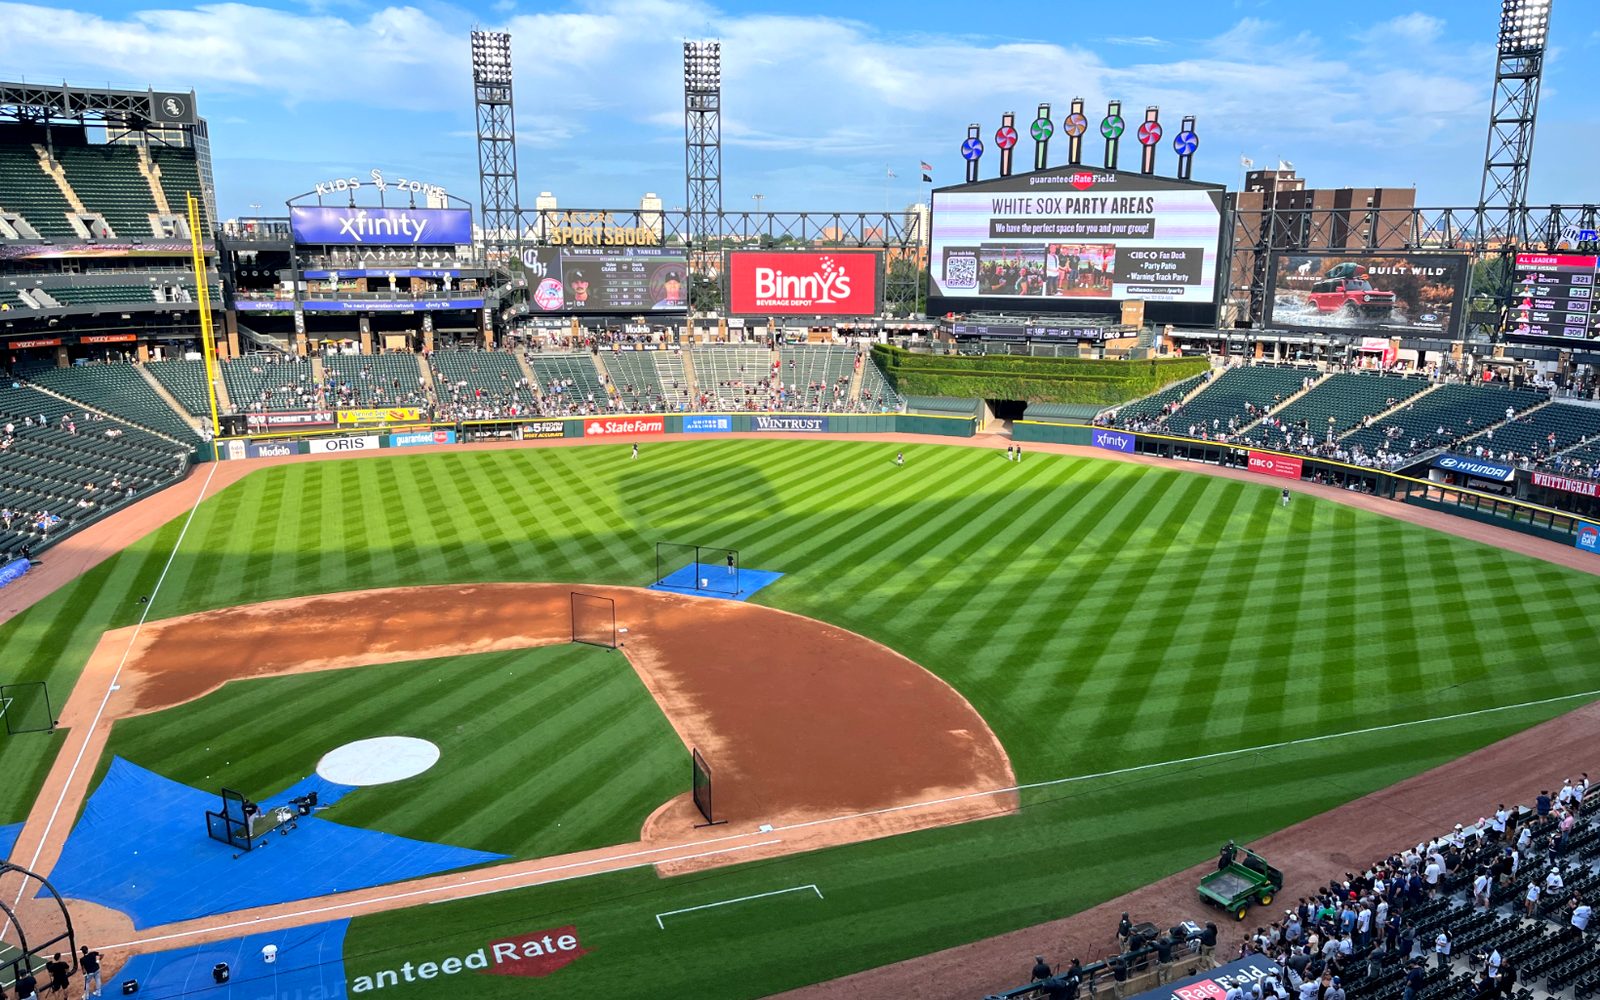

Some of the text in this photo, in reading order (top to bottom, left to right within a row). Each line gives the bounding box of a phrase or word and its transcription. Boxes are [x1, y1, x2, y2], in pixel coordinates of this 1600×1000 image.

[1029, 175, 1073, 185] guaranteed
[1074, 174, 1091, 183] Rate
[315, 177, 446, 199] KIDS ZONE
[992, 196, 1154, 214] WHITE SOX PARTY AREAS
[339, 211, 427, 242] xfinity
[995, 223, 1149, 235] We have the perfect space for you and your group!
[551, 227, 657, 245] SPORTSBOOK
[1130, 251, 1186, 259] CIBC Fan Deck
[1144, 261, 1177, 271] Party Patio
[1368, 266, 1407, 275] BUILT
[1131, 272, 1189, 282] Warning Track Party
[756, 266, 851, 303] Binny's
[365, 302, 392, 310] generation
[625, 324, 650, 334] Modelo
[533, 423, 542, 433] 5
[605, 420, 662, 433] State Farm
[757, 417, 823, 430] WINTRUST
[326, 438, 365, 451] ORIS
[397, 432, 433, 447] guaranteed
[1097, 430, 1129, 450] xfinity
[259, 446, 290, 457] Modelo
[1249, 458, 1266, 468] CIBC
[1457, 461, 1507, 478] HYUNDAI
[1534, 472, 1596, 496] WHITTINGHAM
[493, 934, 578, 964] Rate
